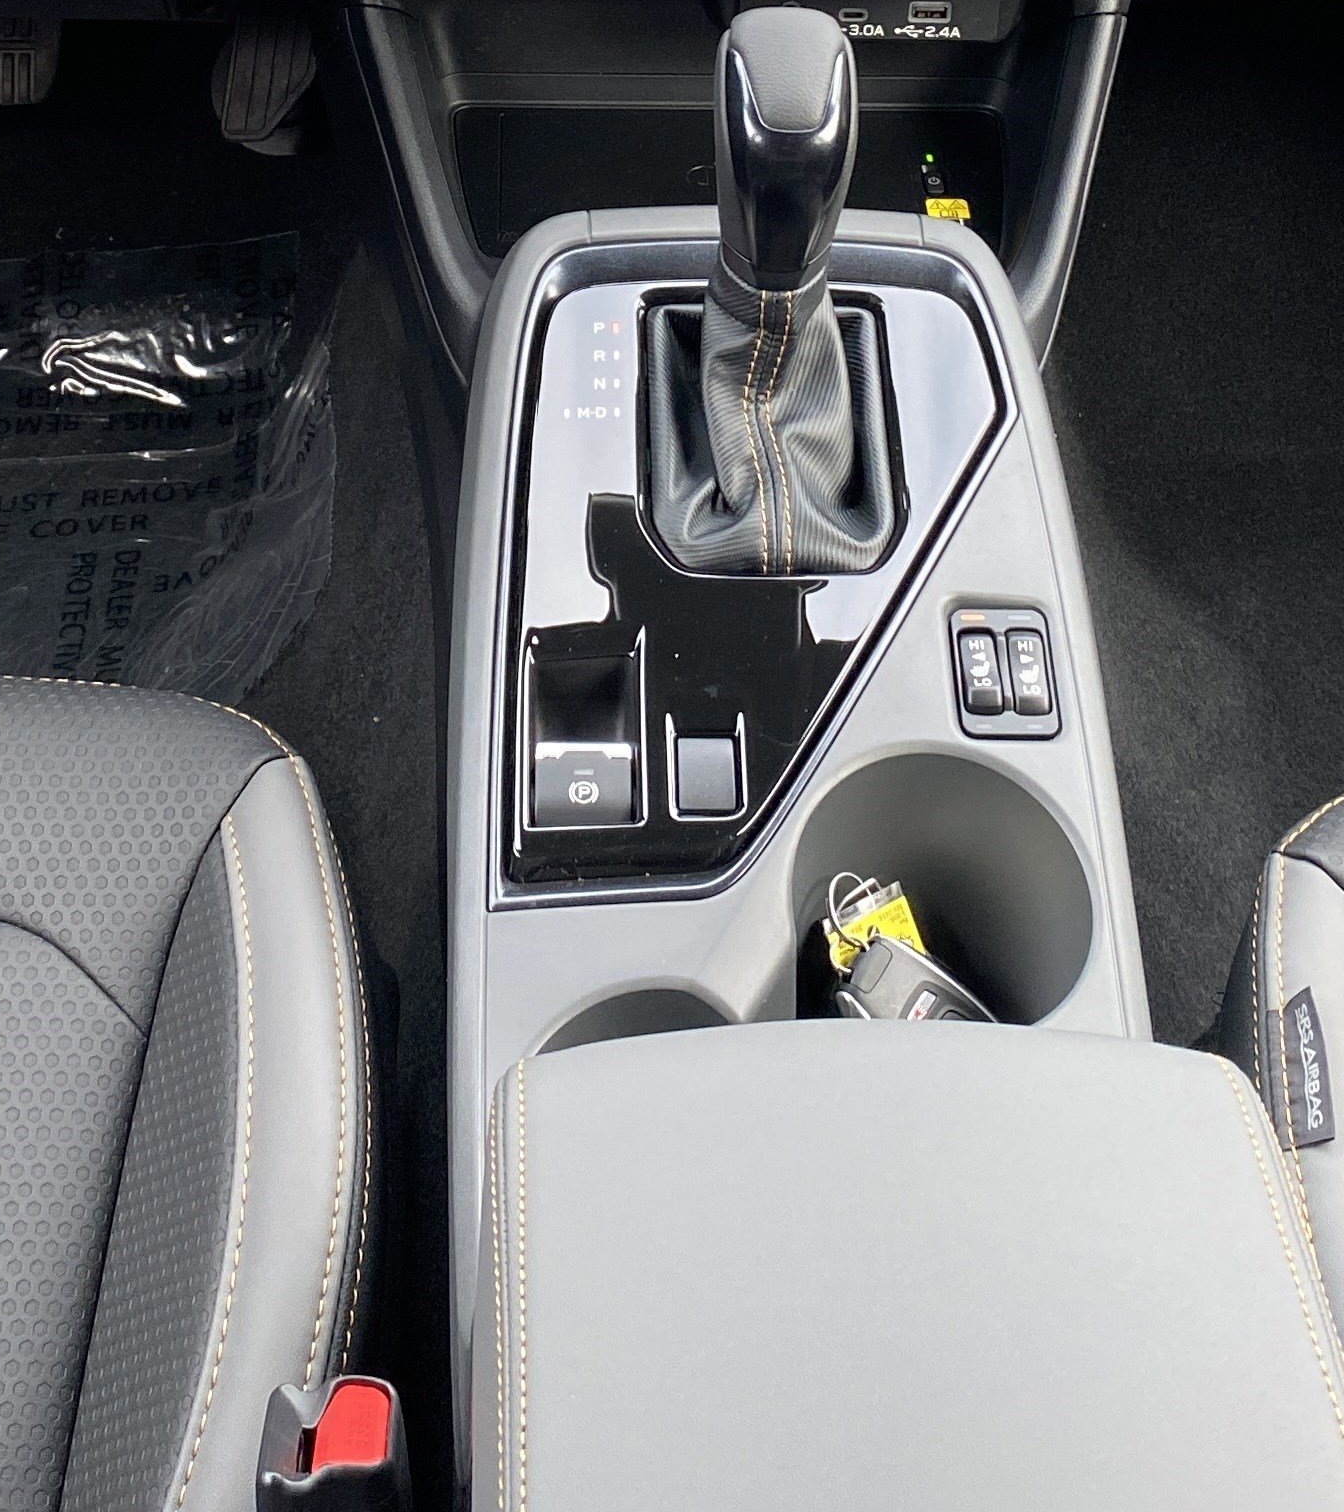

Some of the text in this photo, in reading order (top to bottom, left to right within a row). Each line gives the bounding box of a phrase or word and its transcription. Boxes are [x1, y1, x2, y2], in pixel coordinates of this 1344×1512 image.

[848, 25, 884, 36] 3.0A
[925, 26, 960, 37] 2.4A
[593, 322, 605, 334] P
[594, 350, 606, 361] R
[594, 378, 606, 390] N
[81, 477, 222, 507] REMOVE
[29, 513, 149, 540] COVER
[104, 549, 142, 631] DEALER
[53, 551, 98, 679] PROTECTIV
[969, 640, 984, 650] HI
[1017, 641, 1033, 651] HI
[974, 678, 992, 686] LO
[1023, 685, 1041, 695] LO
[1295, 1002, 1323, 1130] SRS AIRBAG
